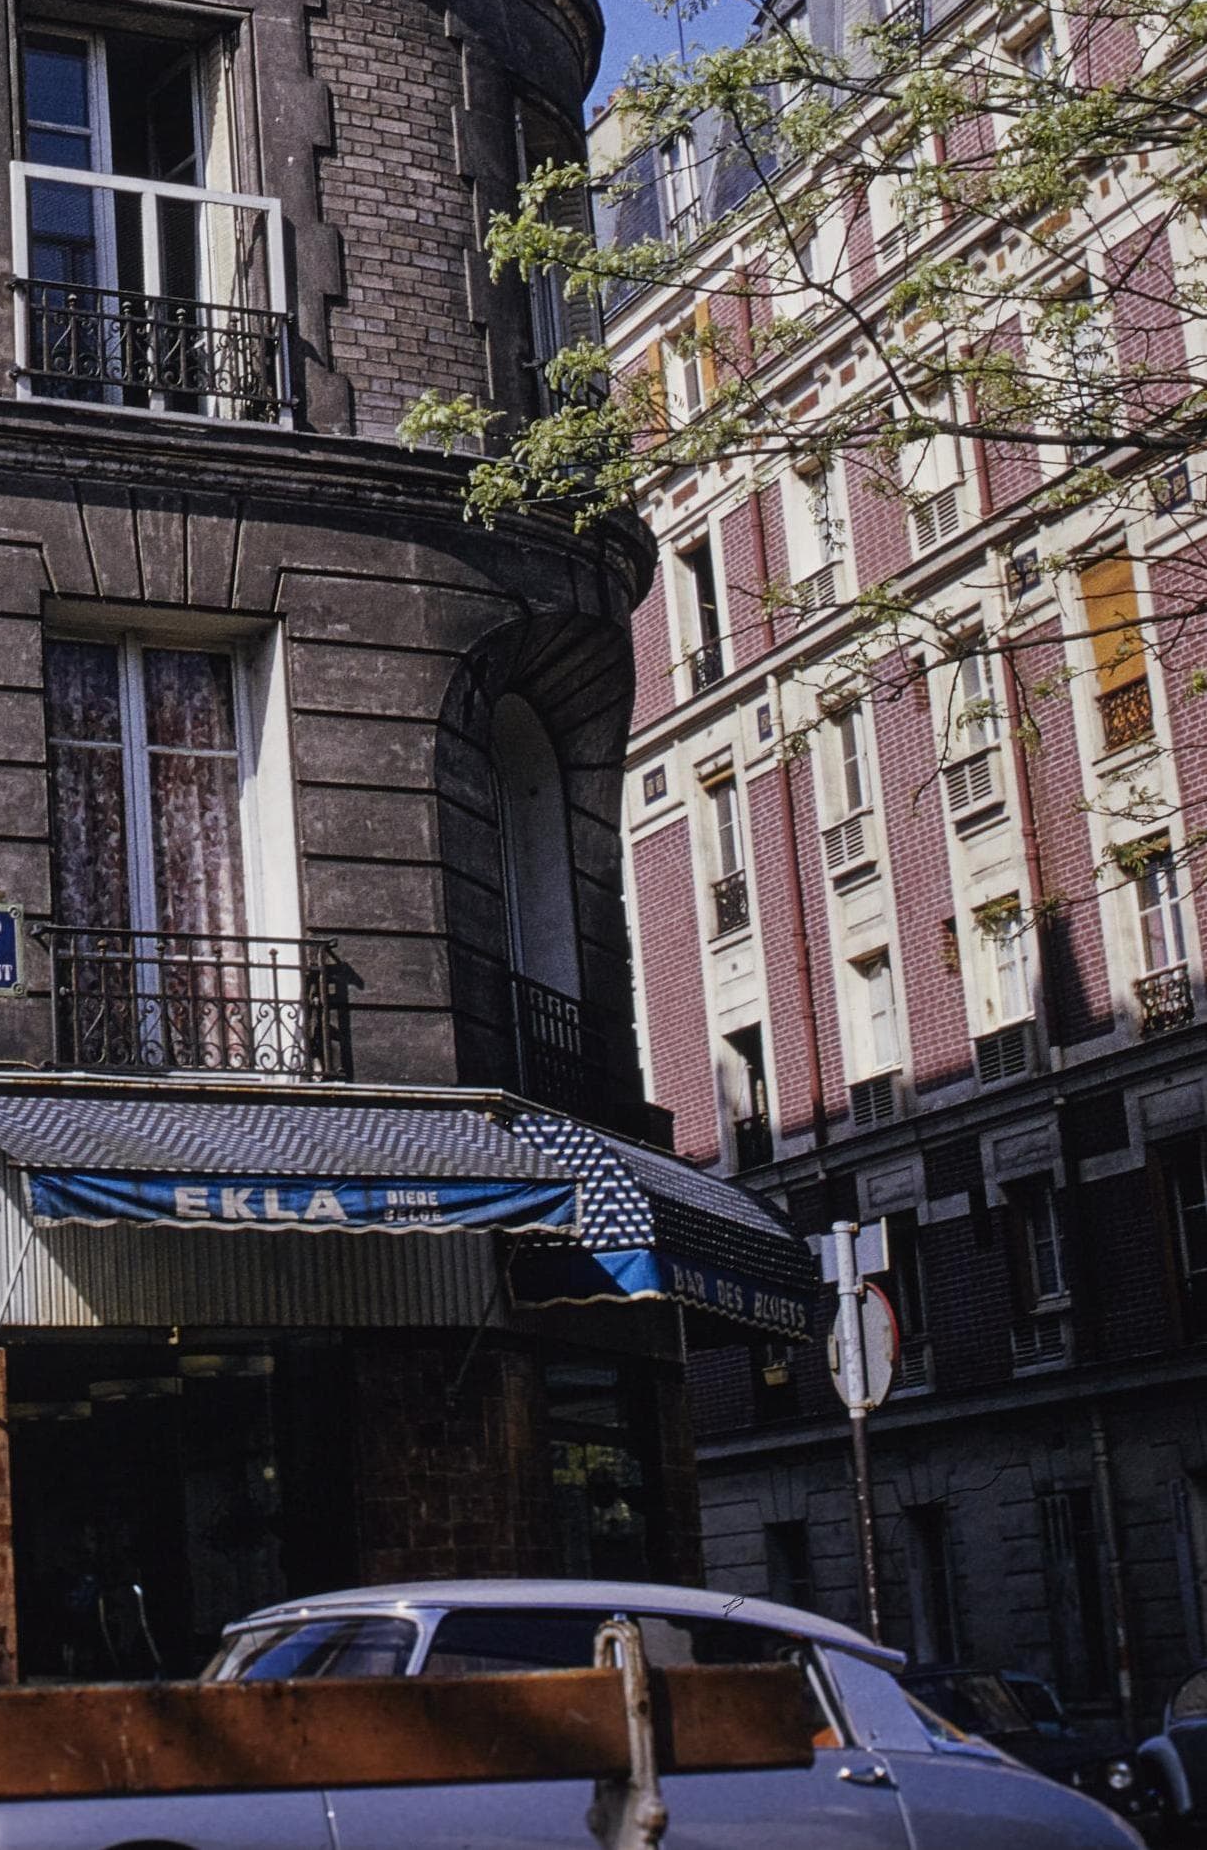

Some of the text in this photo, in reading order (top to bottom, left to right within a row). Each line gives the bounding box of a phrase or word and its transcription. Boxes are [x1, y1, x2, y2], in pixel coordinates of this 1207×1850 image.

[174, 1186, 348, 1220] EKLA
[672, 1263, 807, 1329] BAR DES BLUETS
